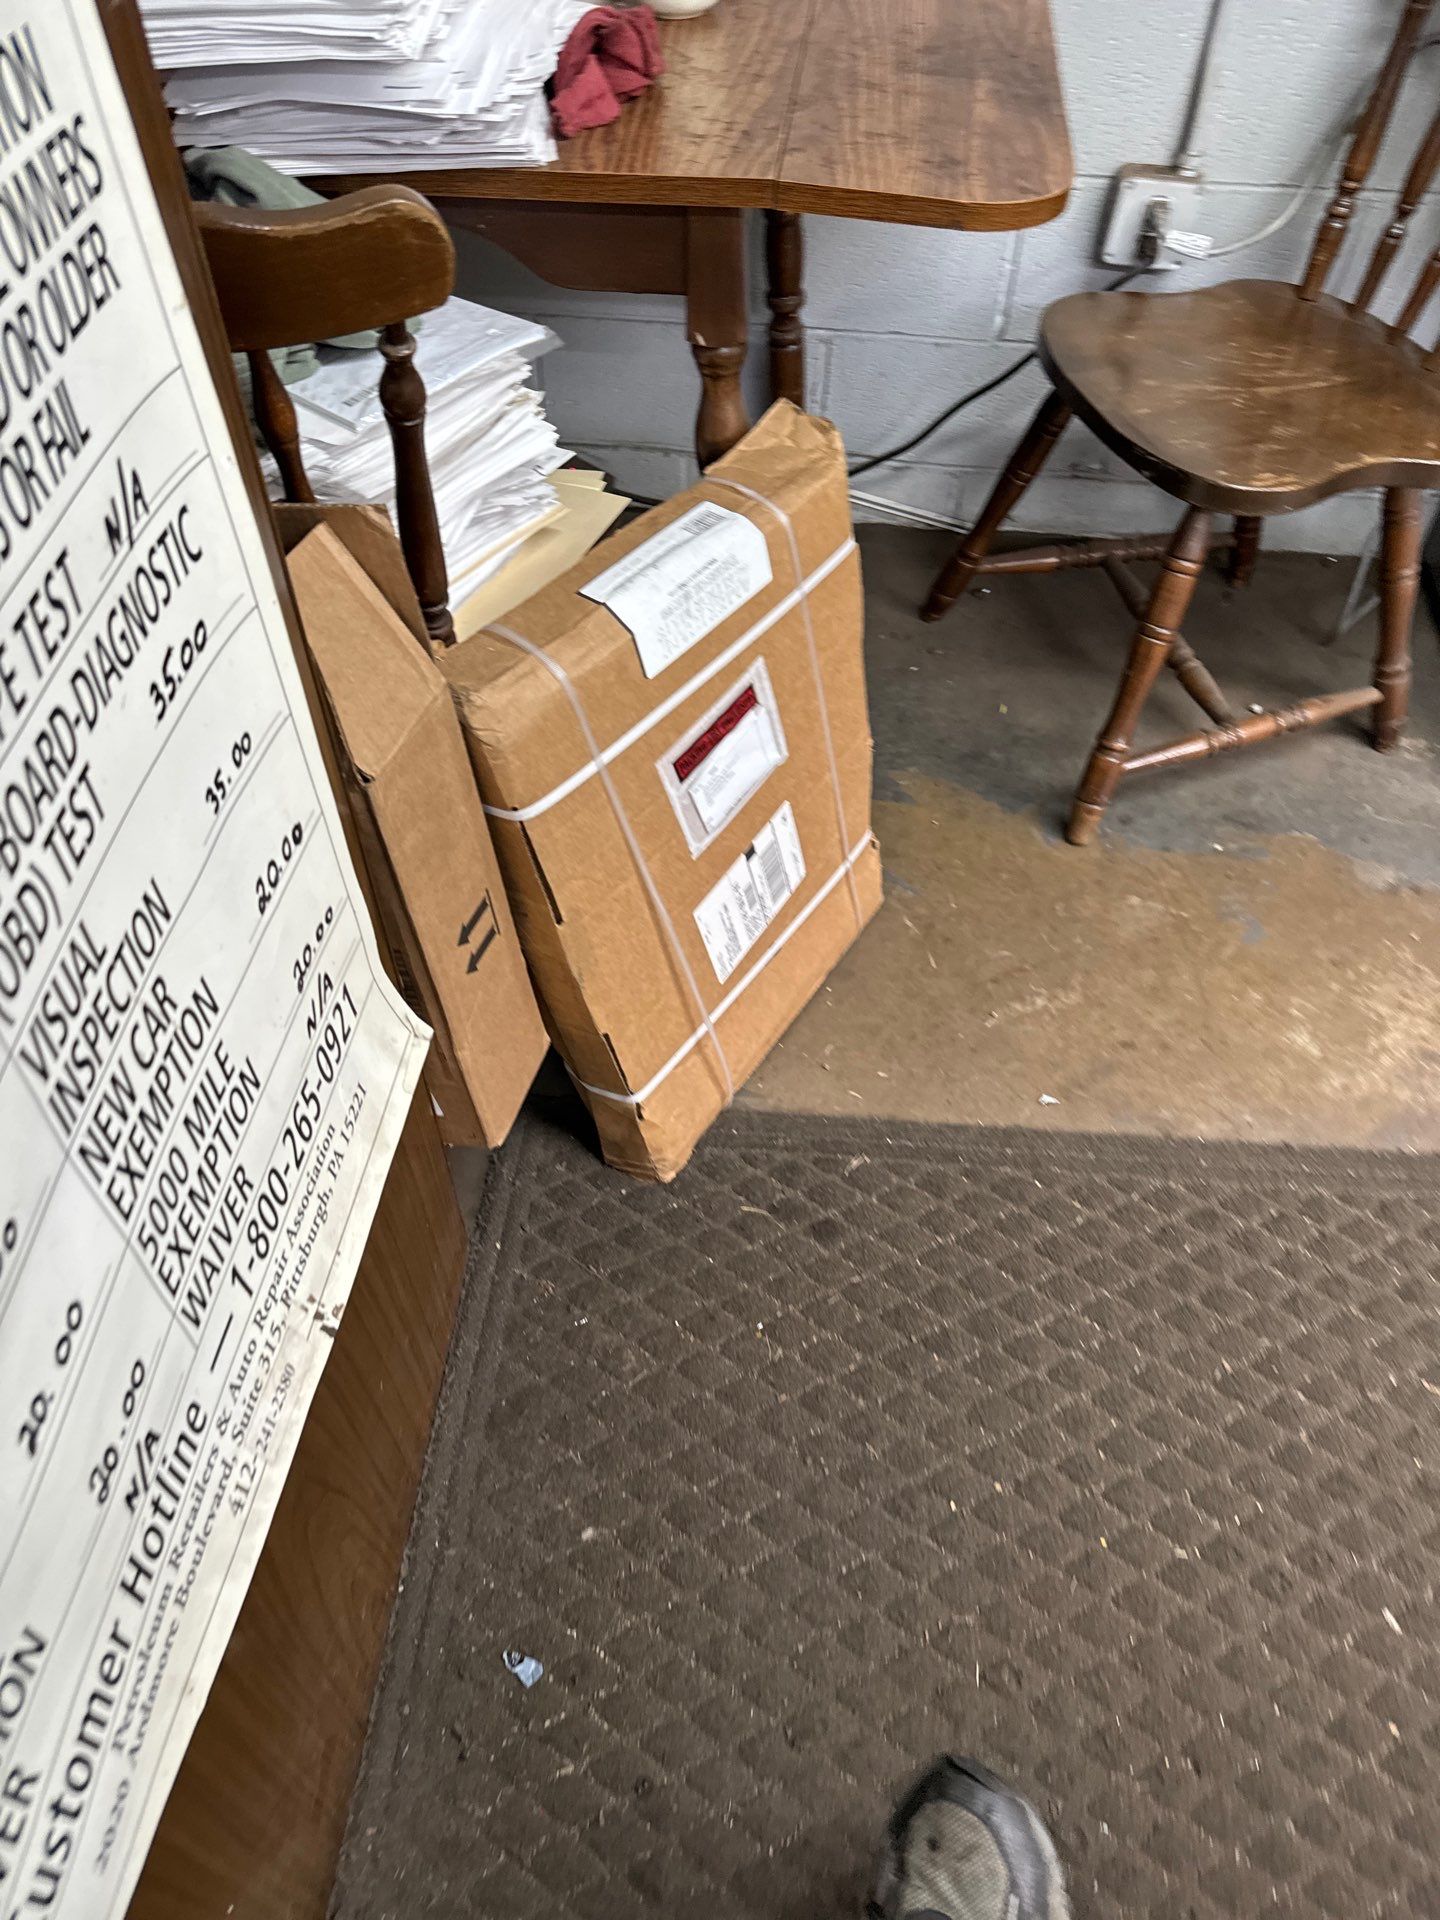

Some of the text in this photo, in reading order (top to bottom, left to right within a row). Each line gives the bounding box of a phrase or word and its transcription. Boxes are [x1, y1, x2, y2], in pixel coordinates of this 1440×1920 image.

[0, 22, 53, 153] ION
[0, 114, 102, 277] OWNERS
[3, 222, 121, 398] OR OLDER
[1, 377, 91, 528] OR FAIL
[104, 456, 149, 556] N/A
[13, 546, 82, 680] TEST
[150, 619, 207, 722] 35.00
[43, 761, 104, 884] TEST
[205, 731, 252, 815] 35.00
[257, 822, 304, 915] 20.00
[293, 906, 333, 993] 20.00
[20, 918, 107, 1083] VISUAL
[50, 877, 171, 1136] INSPECTION
[78, 976, 177, 1185] NEW CAR
[306, 970, 334, 1040] N/A
[106, 976, 220, 1222] EXEMPTION
[138, 1038, 237, 1266] 5000 MILE
[158, 1057, 262, 1298] EXEMPTION
[121, 1402, 207, 1608] Hotline
[231, 984, 361, 1300] 1-800-265-0921
[180, 1163, 255, 1330] WAIVER
[175, 1450, 239, 1614] Boulevard,
[232, 1374, 265, 1448] Suite
[256, 1319, 288, 1375] 315,
[280, 1186, 337, 1311] Pittsburgh,
[327, 1148, 346, 1181] PA
[338, 1081, 369, 1147] 15221
[112, 1123, 337, 1752] Petroleum Retailers & Auto Repair Association
[230, 1364, 296, 1519] 412-241-2380
